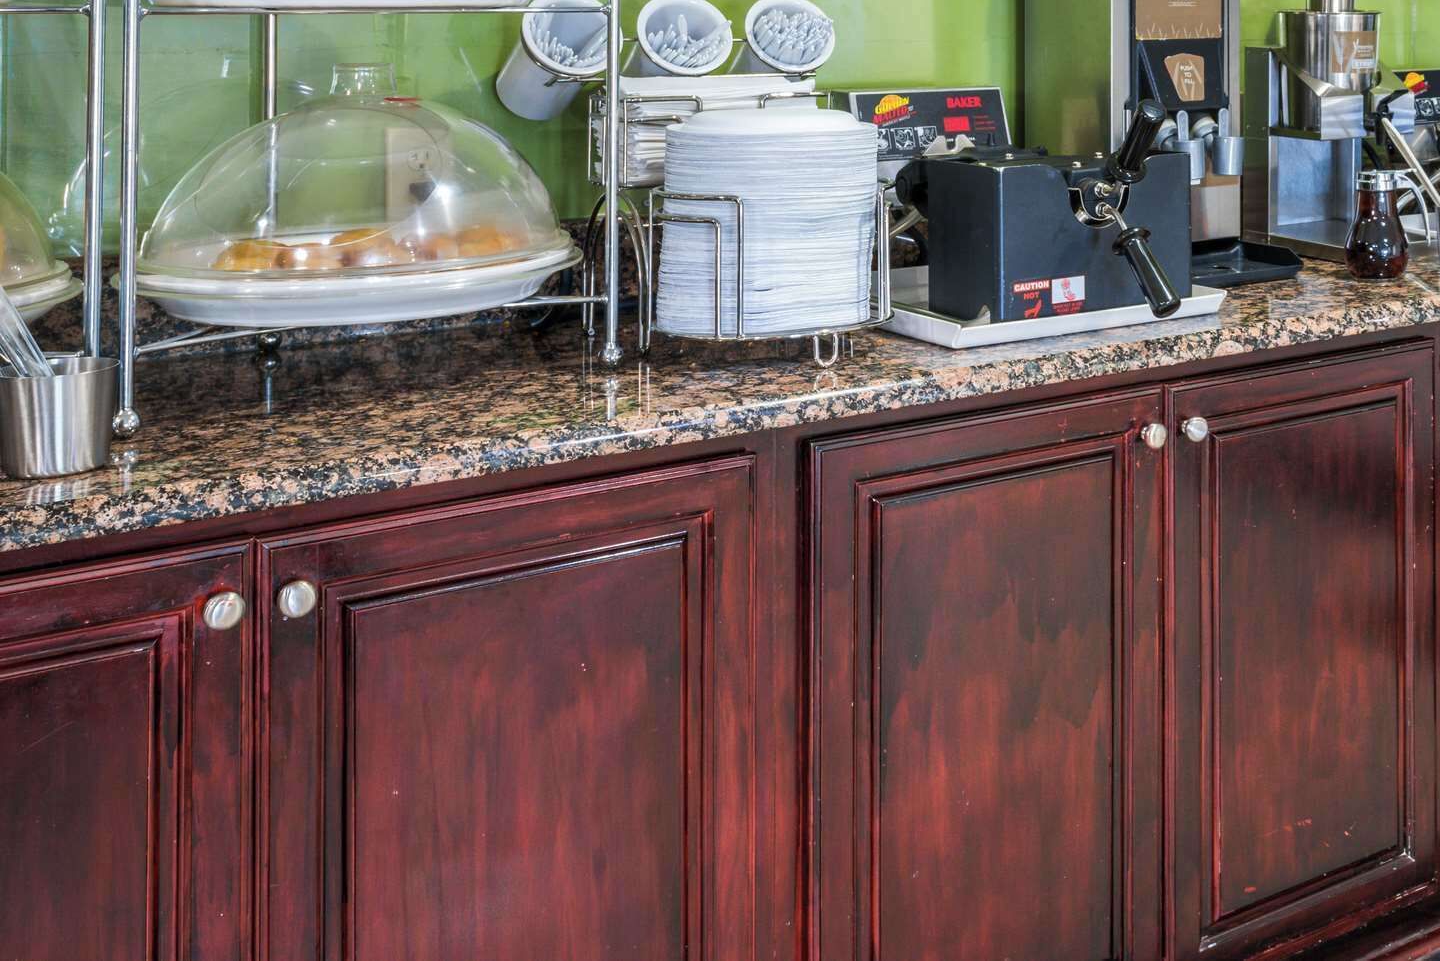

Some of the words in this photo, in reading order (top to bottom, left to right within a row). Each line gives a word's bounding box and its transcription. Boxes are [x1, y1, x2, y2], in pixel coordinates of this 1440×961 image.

[946, 95, 982, 109] BAKER
[1013, 279, 1050, 293] CAUTION
[1023, 291, 1040, 300] HOT
